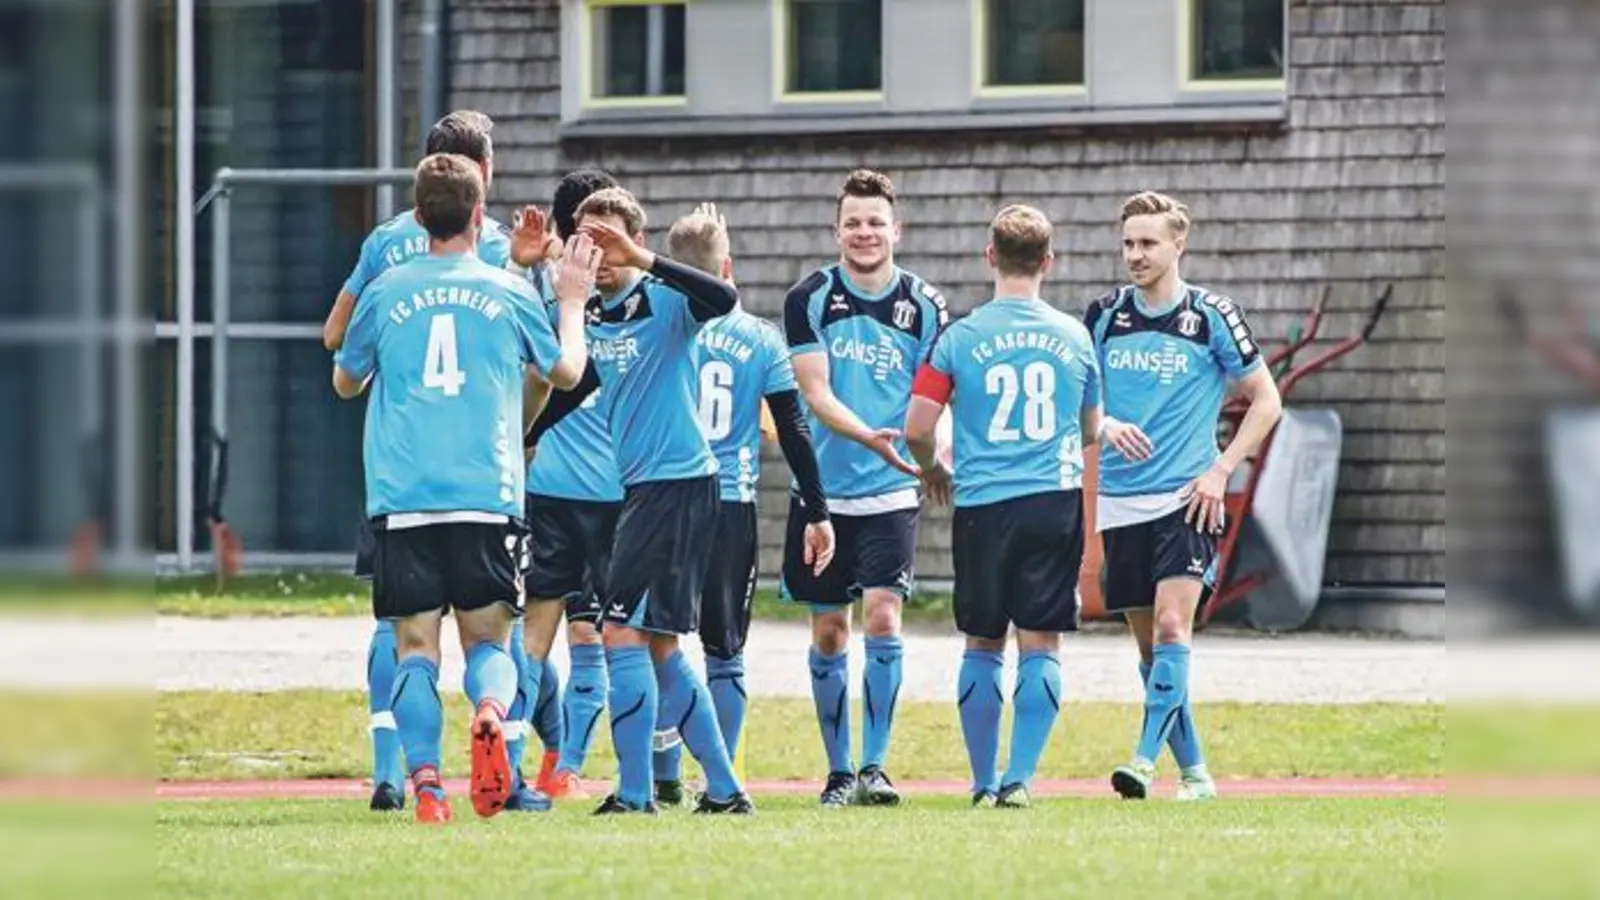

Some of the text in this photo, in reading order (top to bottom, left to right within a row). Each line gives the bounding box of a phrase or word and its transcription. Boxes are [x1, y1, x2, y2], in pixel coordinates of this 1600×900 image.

[389, 286, 502, 325] FC ASCHHEIM
[422, 313, 466, 397] 4
[831, 335, 903, 381] GANSER
[971, 341, 994, 364] FC
[1108, 341, 1189, 385] GANSER
[985, 360, 1056, 443] 28
